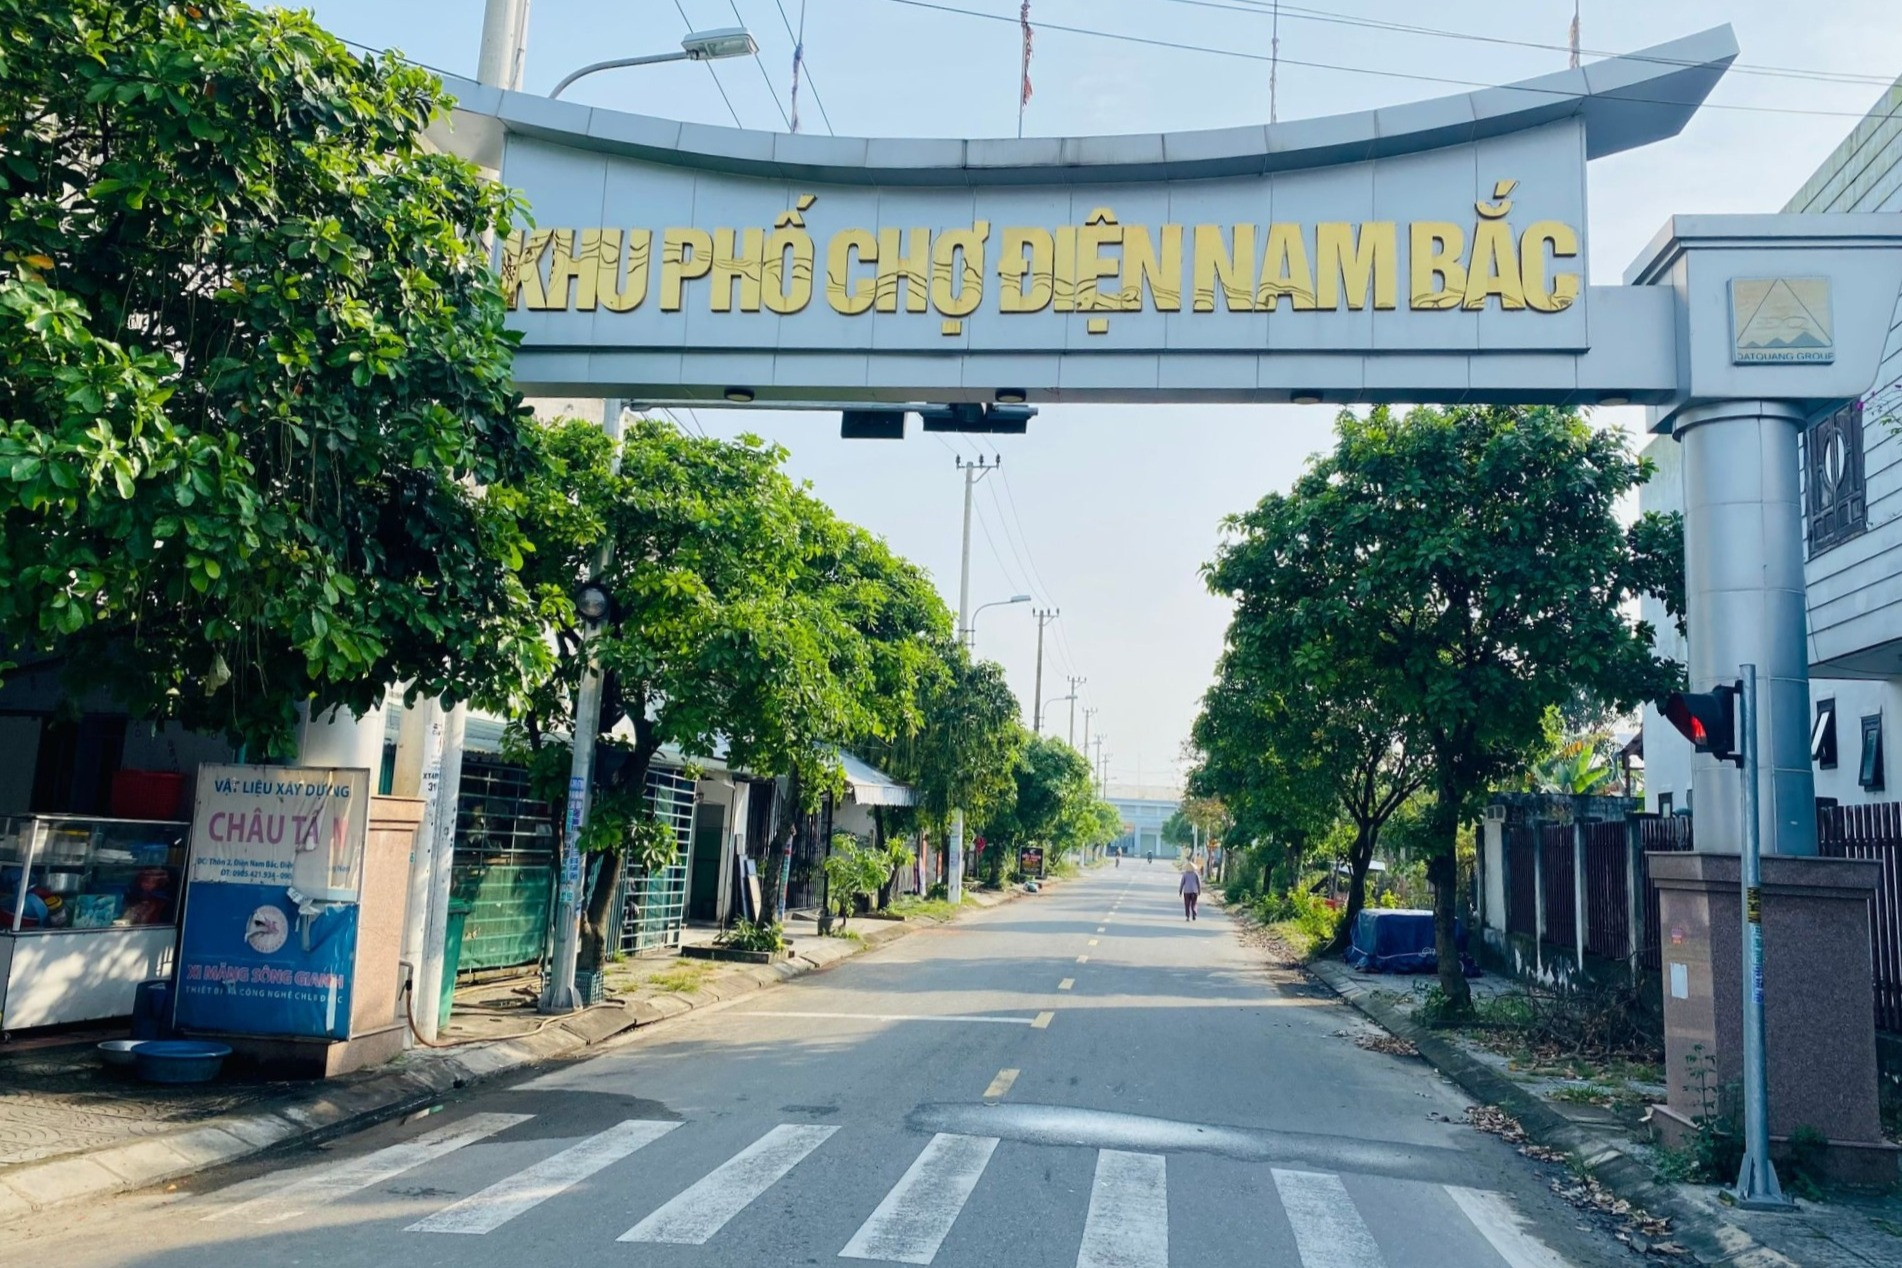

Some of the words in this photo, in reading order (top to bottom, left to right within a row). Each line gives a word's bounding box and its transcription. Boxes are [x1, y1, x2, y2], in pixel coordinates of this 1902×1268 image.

[501, 229, 652, 314] KHU
[660, 194, 818, 316] PHỐ
[827, 220, 991, 336] CHỢ
[998, 207, 1184, 334] ĐIỆN
[1193, 221, 1397, 313] NAM
[1409, 179, 1578, 314] BẮC
[242, 779, 273, 797] LIỆU
[208, 807, 285, 845] CHÂU
[186, 964, 202, 980] XI
[203, 961, 249, 983] MĂNG
[251, 964, 292, 985] SÔNG
